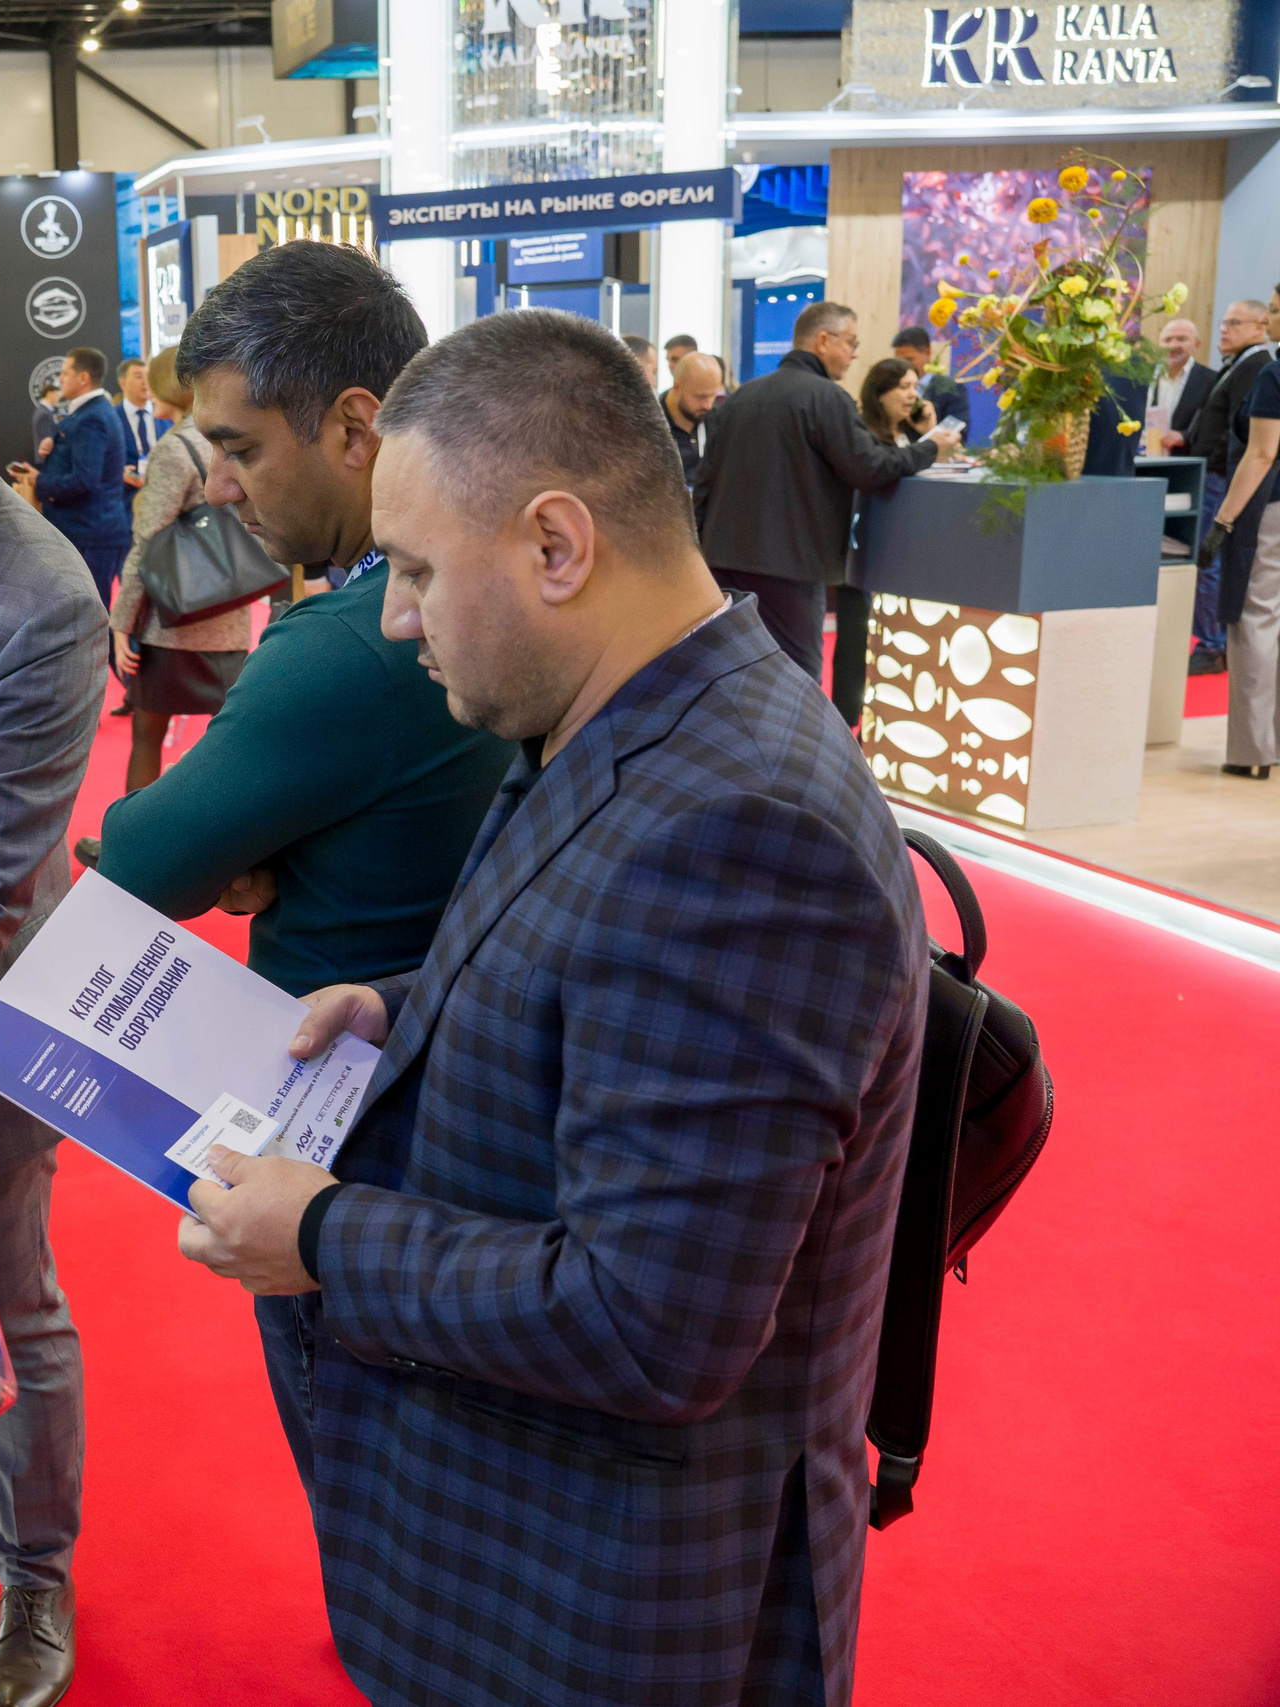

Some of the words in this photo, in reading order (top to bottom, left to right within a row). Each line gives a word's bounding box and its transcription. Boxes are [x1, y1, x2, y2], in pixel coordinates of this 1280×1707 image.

[1055, 4, 1159, 41] KALA
[921, 7, 1046, 88] KR
[1052, 46, 1178, 85] RANTA
[256, 186, 368, 216] NORD
[388, 201, 500, 226] ЭКСПЕРТЫ
[504, 198, 537, 217] НА
[540, 192, 615, 215] РЫНКЕ
[619, 185, 715, 208] ФОРЕЛИ
[69, 964, 115, 1020] КАТАЛОГ
[93, 930, 176, 1036] ПРОМЫШЛЕННОГО
[118, 957, 192, 1051] ОБОРУДОВАНИЯ
[266, 1097, 283, 1119] cale
[277, 1055, 310, 1099] Enterpris
[336, 1086, 360, 1120] PRISMA
[275, 1108, 299, 1143] Официальный
[297, 1082, 315, 1109] поставщик
[311, 1134, 335, 1164] CAS
